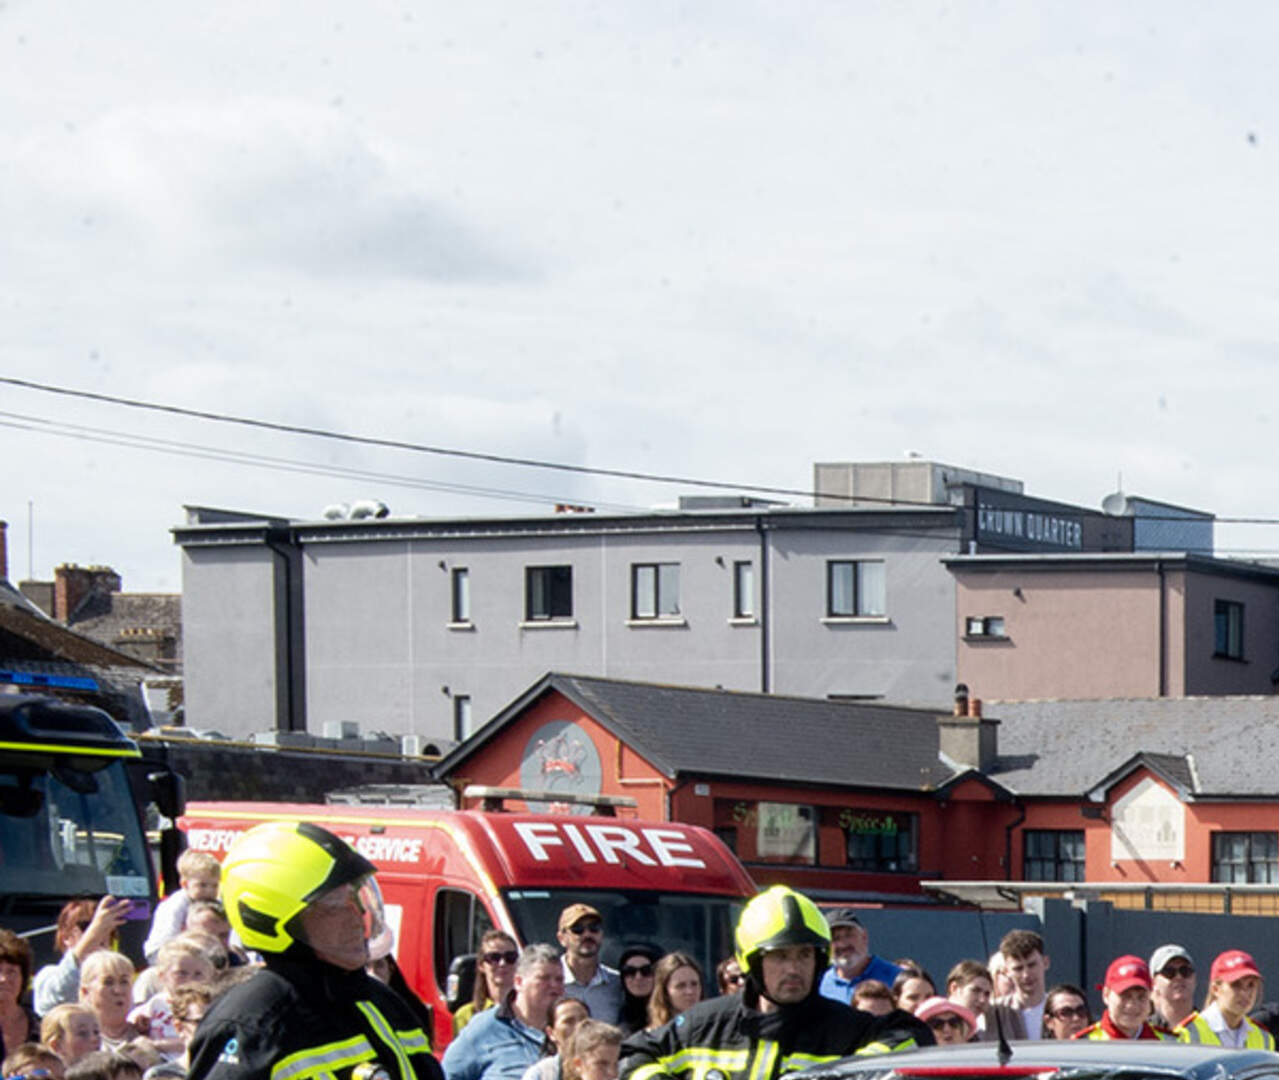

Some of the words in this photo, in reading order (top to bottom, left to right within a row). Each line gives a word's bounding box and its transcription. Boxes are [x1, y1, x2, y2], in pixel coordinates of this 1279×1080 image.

[1027, 512, 1082, 549] QUARTER
[187, 829, 243, 851] WEXFO
[355, 837, 422, 863] SERVICE
[513, 821, 706, 870] FIRE
